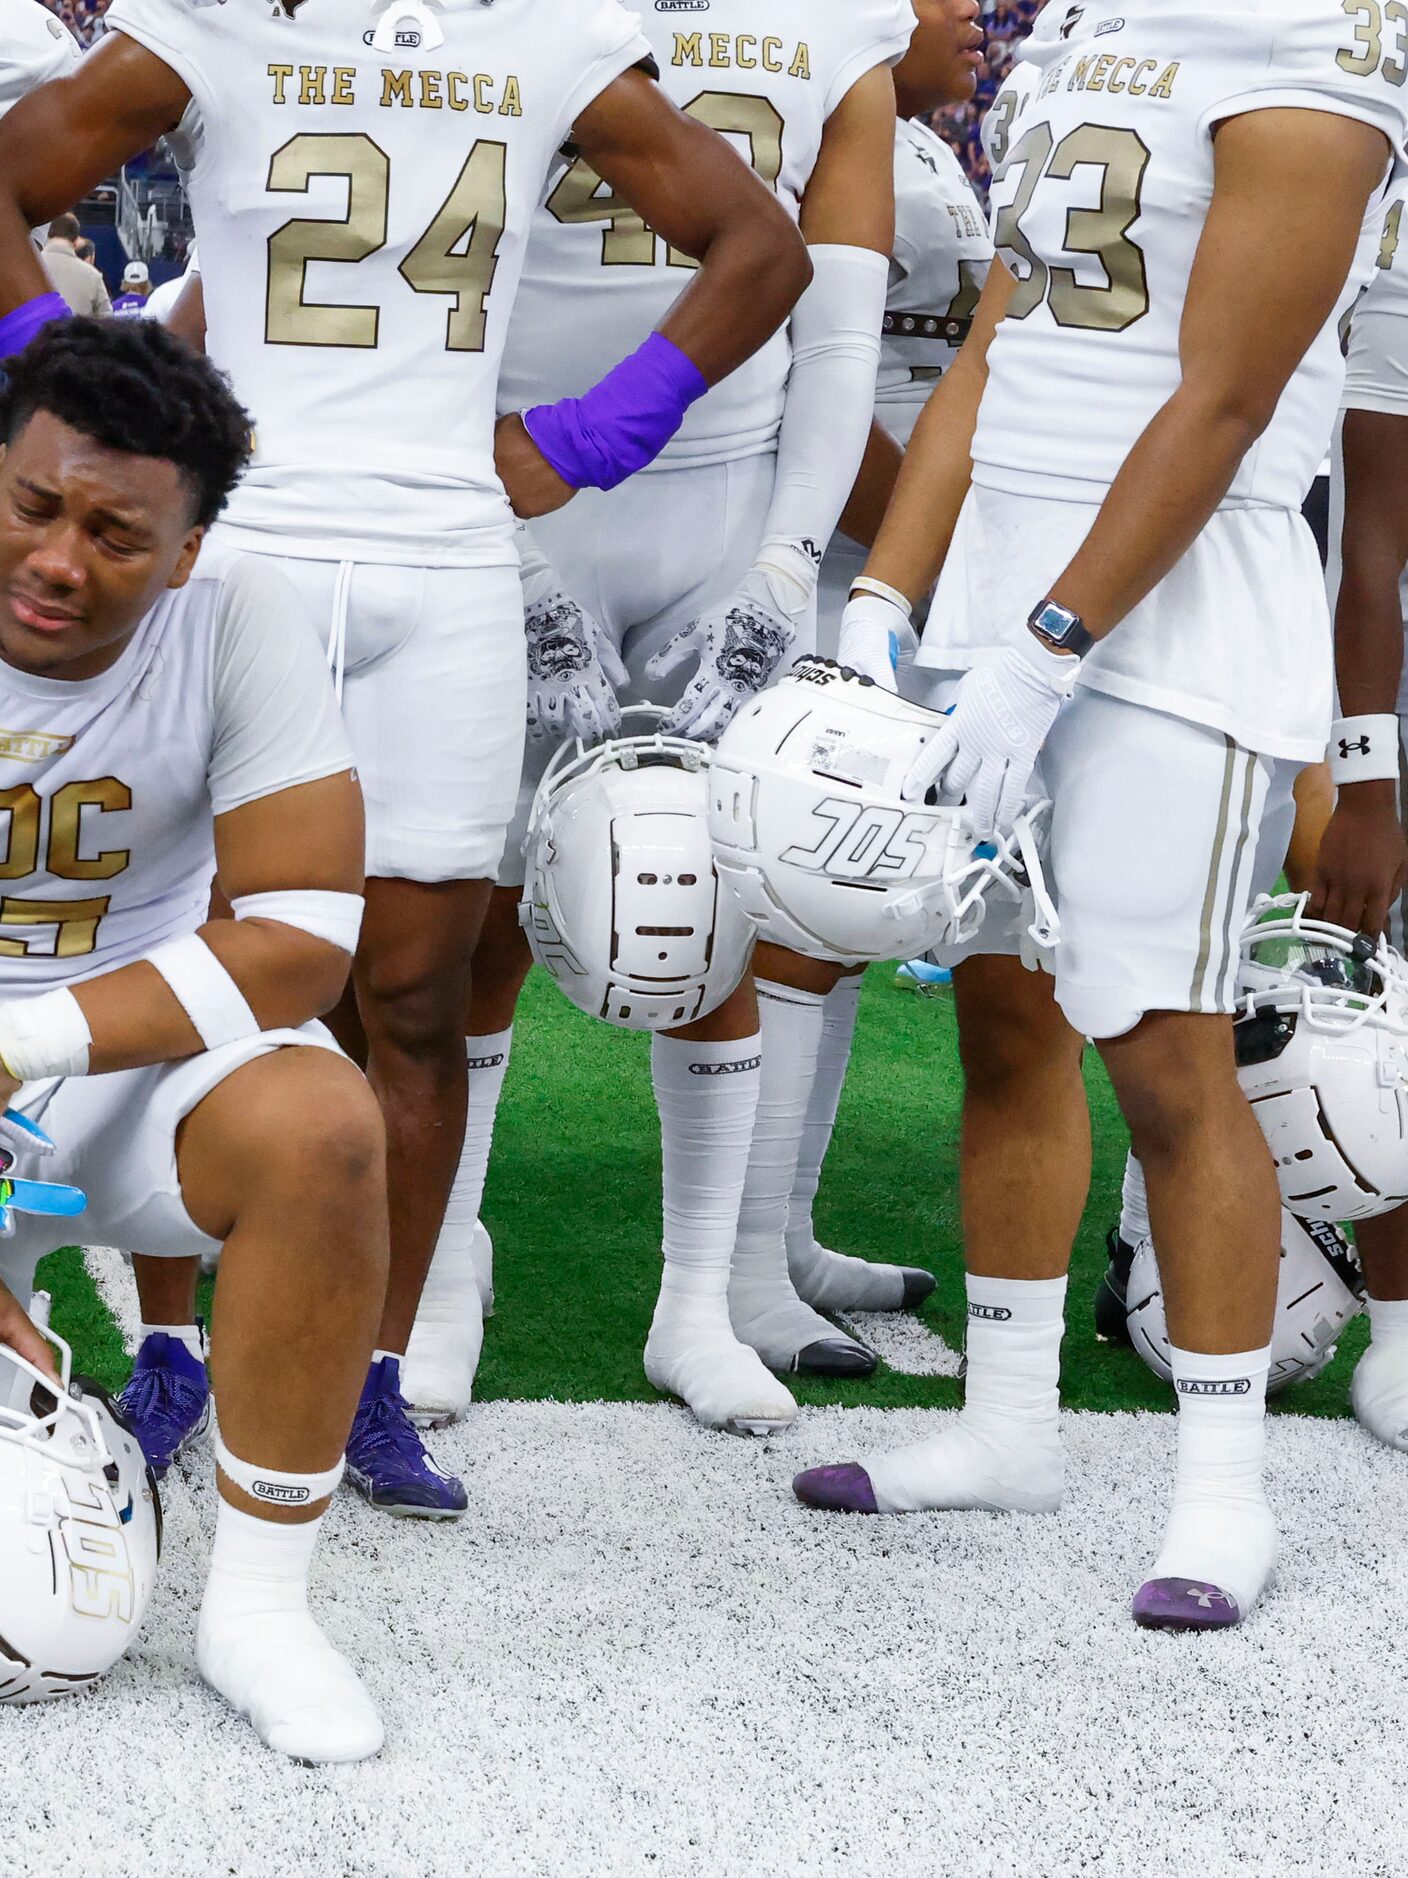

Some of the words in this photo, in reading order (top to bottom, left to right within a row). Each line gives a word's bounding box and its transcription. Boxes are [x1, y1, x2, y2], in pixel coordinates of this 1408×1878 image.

[369, 32, 418, 46] BTLE
[672, 32, 811, 80] MECCA
[268, 64, 356, 105] THE
[380, 68, 523, 117] MECCA
[1067, 54, 1180, 99] MECCA
[264, 132, 508, 353] 24
[992, 120, 1152, 333] 33
[1180, 1381, 1245, 1394] BATTLE
[257, 1483, 307, 1499] BATTLE
